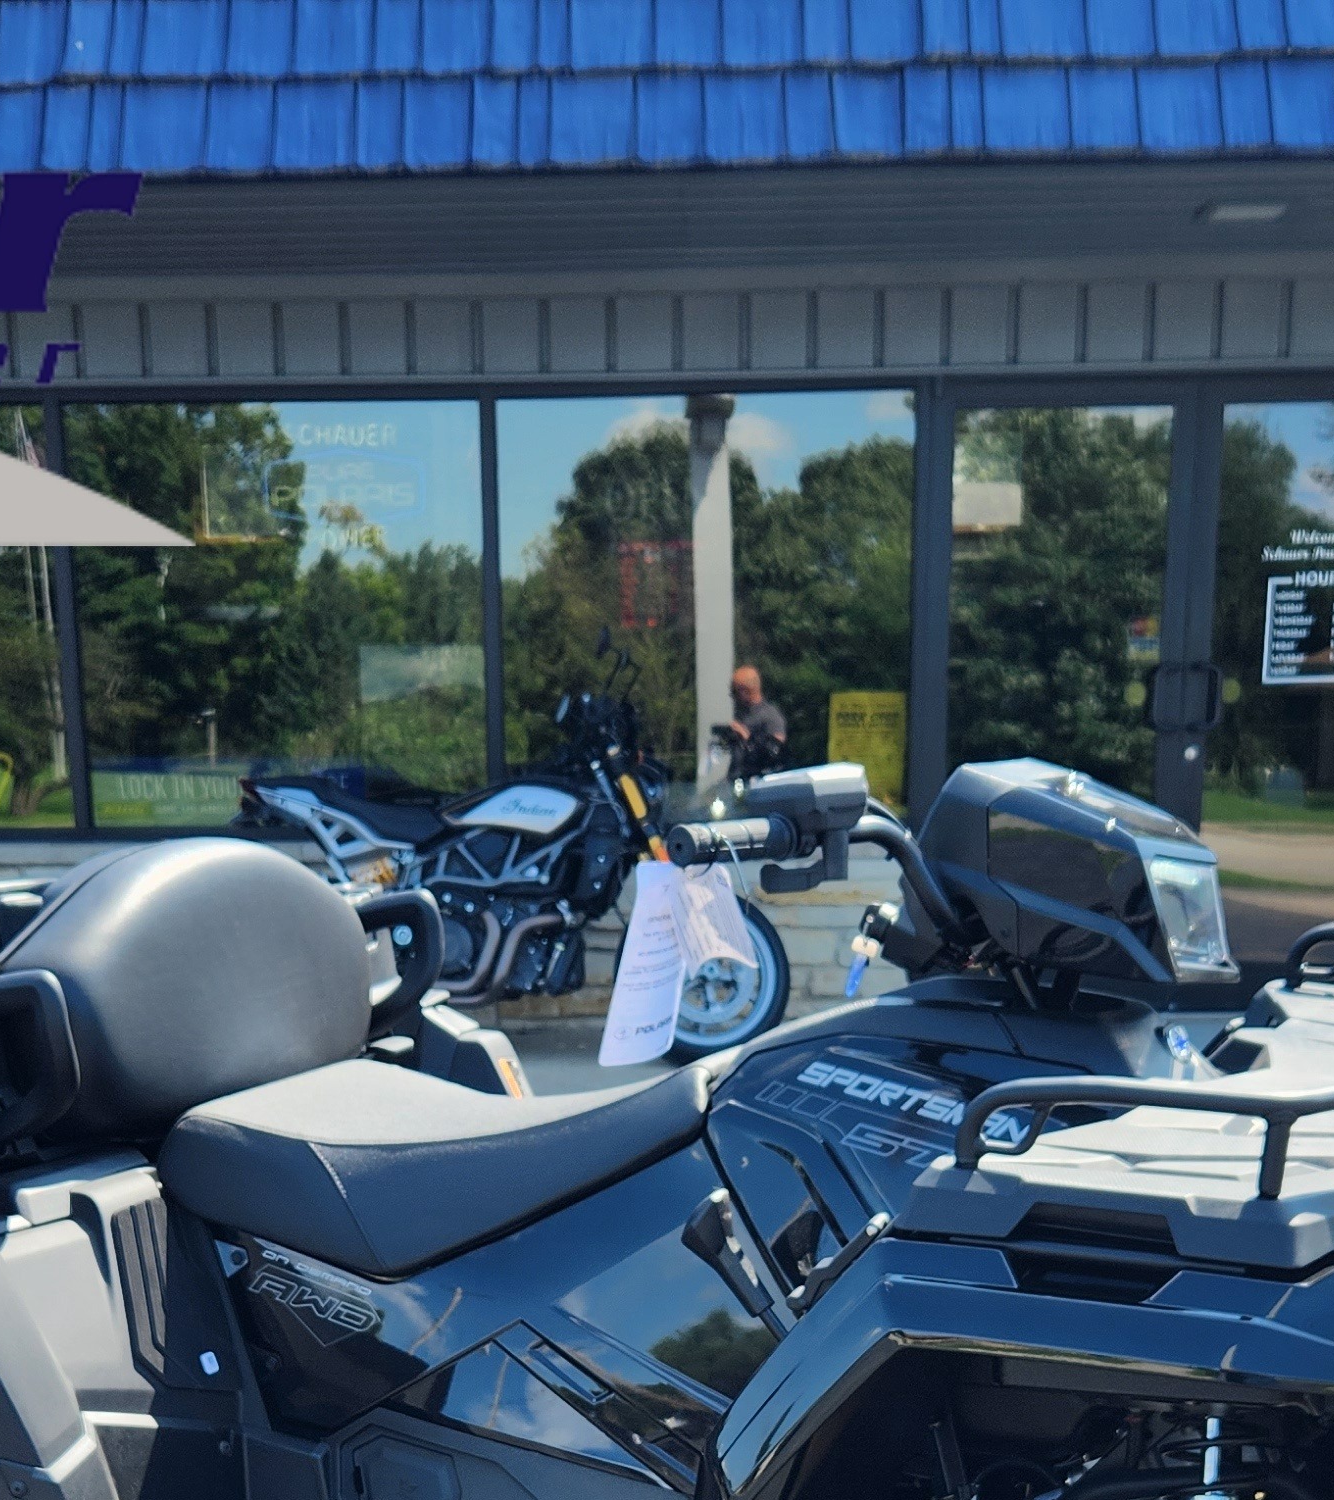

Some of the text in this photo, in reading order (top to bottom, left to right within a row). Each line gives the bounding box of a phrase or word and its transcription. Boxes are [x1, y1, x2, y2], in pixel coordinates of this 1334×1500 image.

[279, 422, 397, 447] CHAUER
[118, 775, 243, 799] LOCK IN YOU
[248, 1271, 377, 1332] AWD
